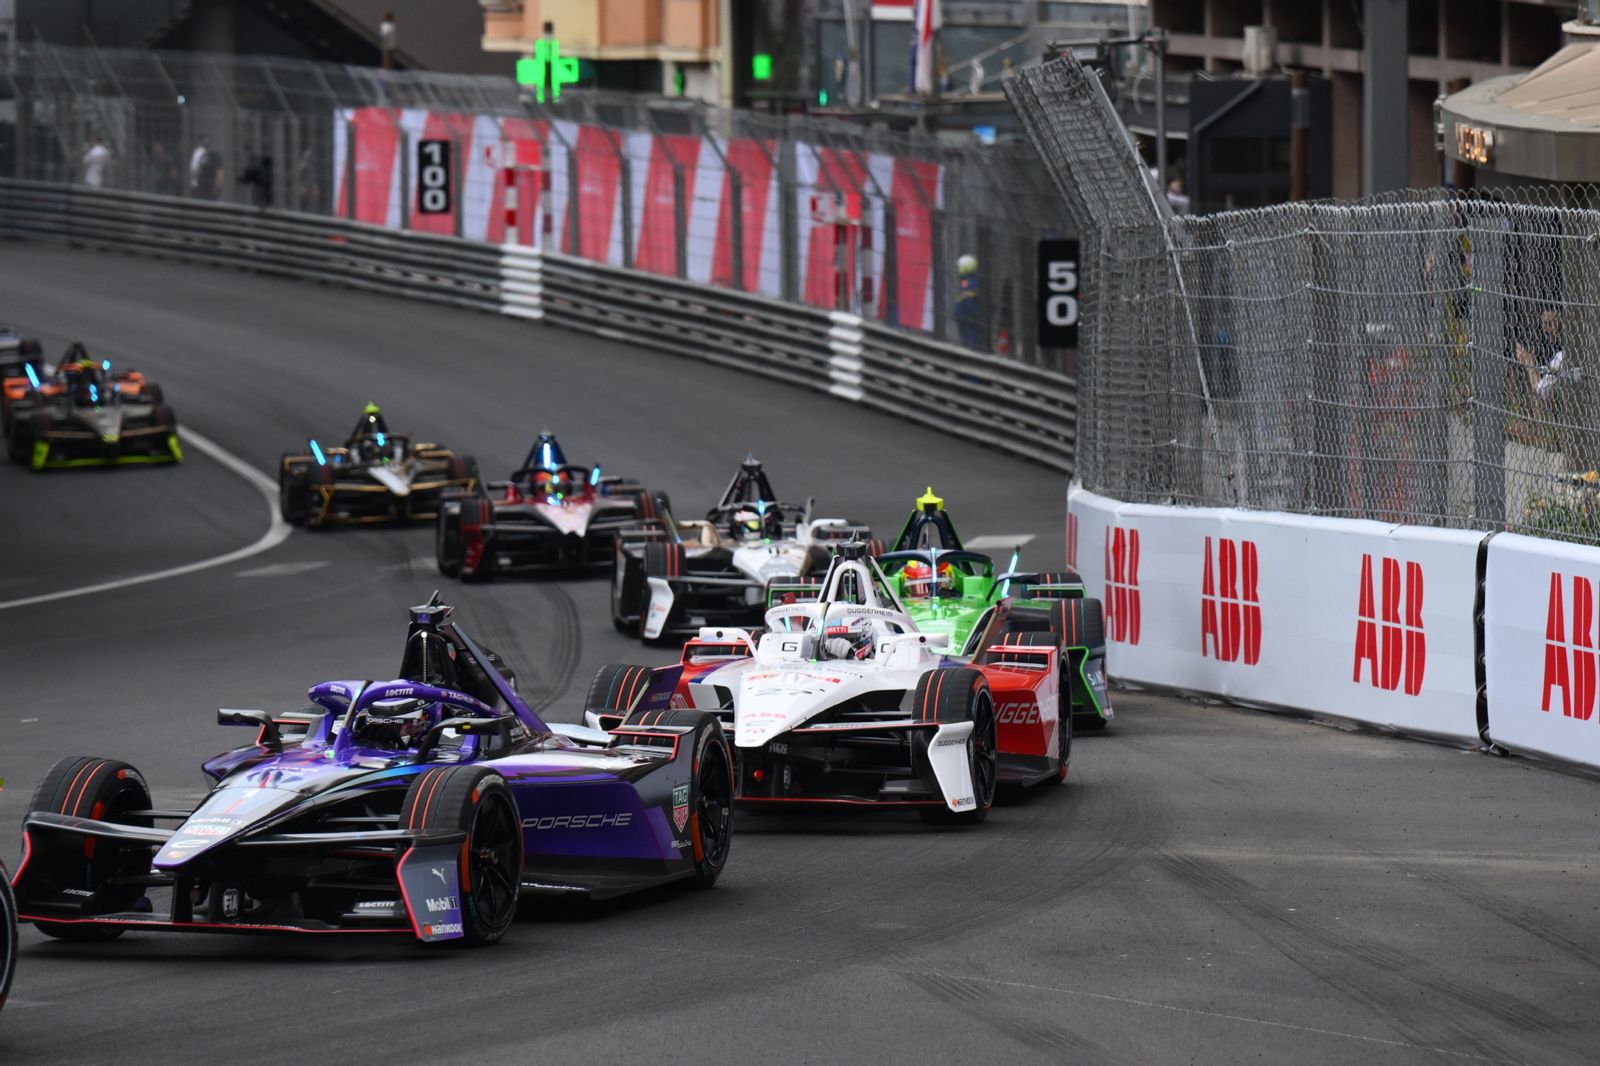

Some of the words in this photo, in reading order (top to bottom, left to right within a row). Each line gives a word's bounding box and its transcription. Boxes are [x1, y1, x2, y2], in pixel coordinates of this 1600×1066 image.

[422, 142, 446, 212] 100
[1046, 261, 1077, 326] 50
[1105, 525, 1141, 646] ABB
[1201, 536, 1262, 666] ABB
[847, 607, 893, 617] GUGGENHEIM
[1353, 553, 1426, 697] ABB
[781, 641, 798, 653] G
[1541, 572, 1600, 724] AB
[385, 687, 414, 698] LOCTITE
[673, 789, 688, 805] TAG
[522, 812, 633, 830] PORSCHE
[426, 897, 450, 912] Mobil
